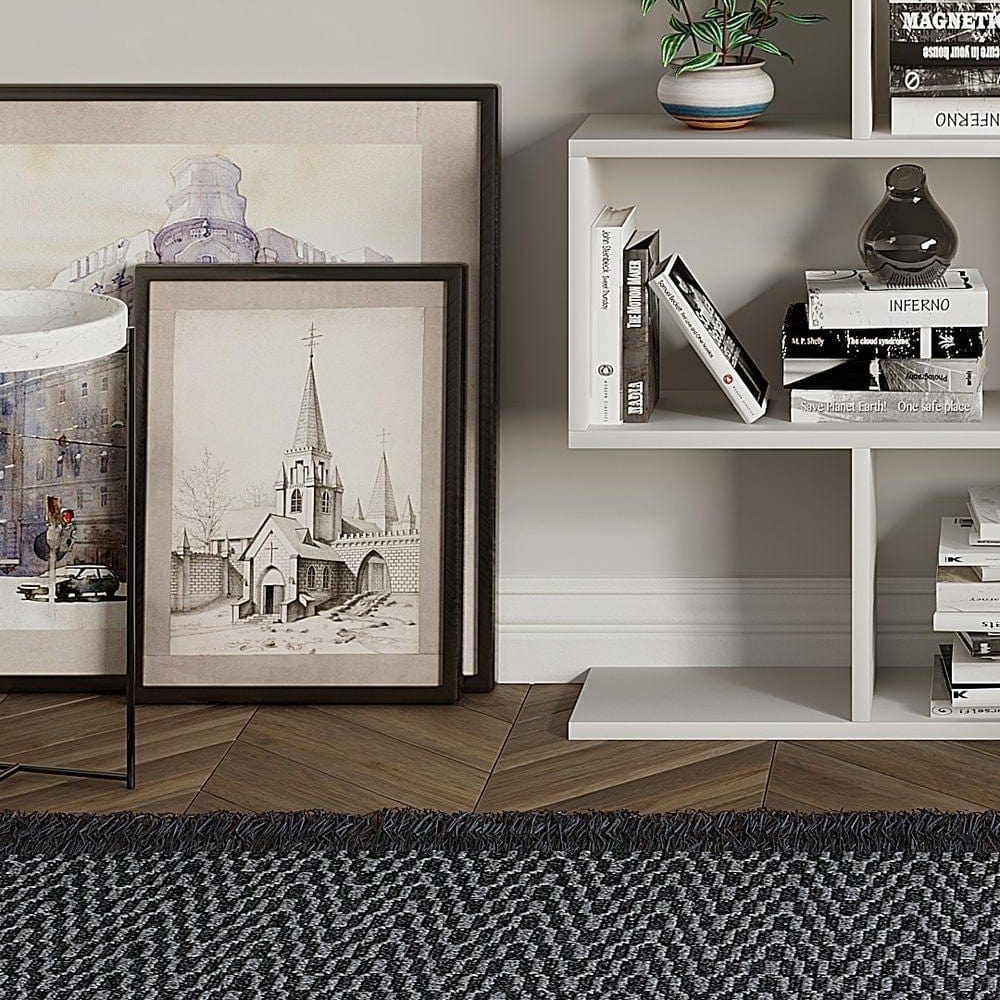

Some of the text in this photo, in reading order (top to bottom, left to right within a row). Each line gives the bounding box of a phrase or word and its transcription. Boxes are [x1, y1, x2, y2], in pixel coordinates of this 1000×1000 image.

[921, 46, 950, 60] house
[949, 44, 970, 60] your
[970, 46, 979, 60] in
[601, 229, 611, 245] John
[602, 244, 611, 272] Steinbeck
[626, 259, 641, 328] THE MOTION MAKER
[658, 280, 683, 311] Samuel Beckett
[890, 298, 950, 312] INFERNO
[847, 337, 908, 347] The cloud syndrome
[906, 372, 948, 382] Photography
[801, 400, 887, 412] Save Planet Earth!
[898, 400, 970, 414] One safe place
